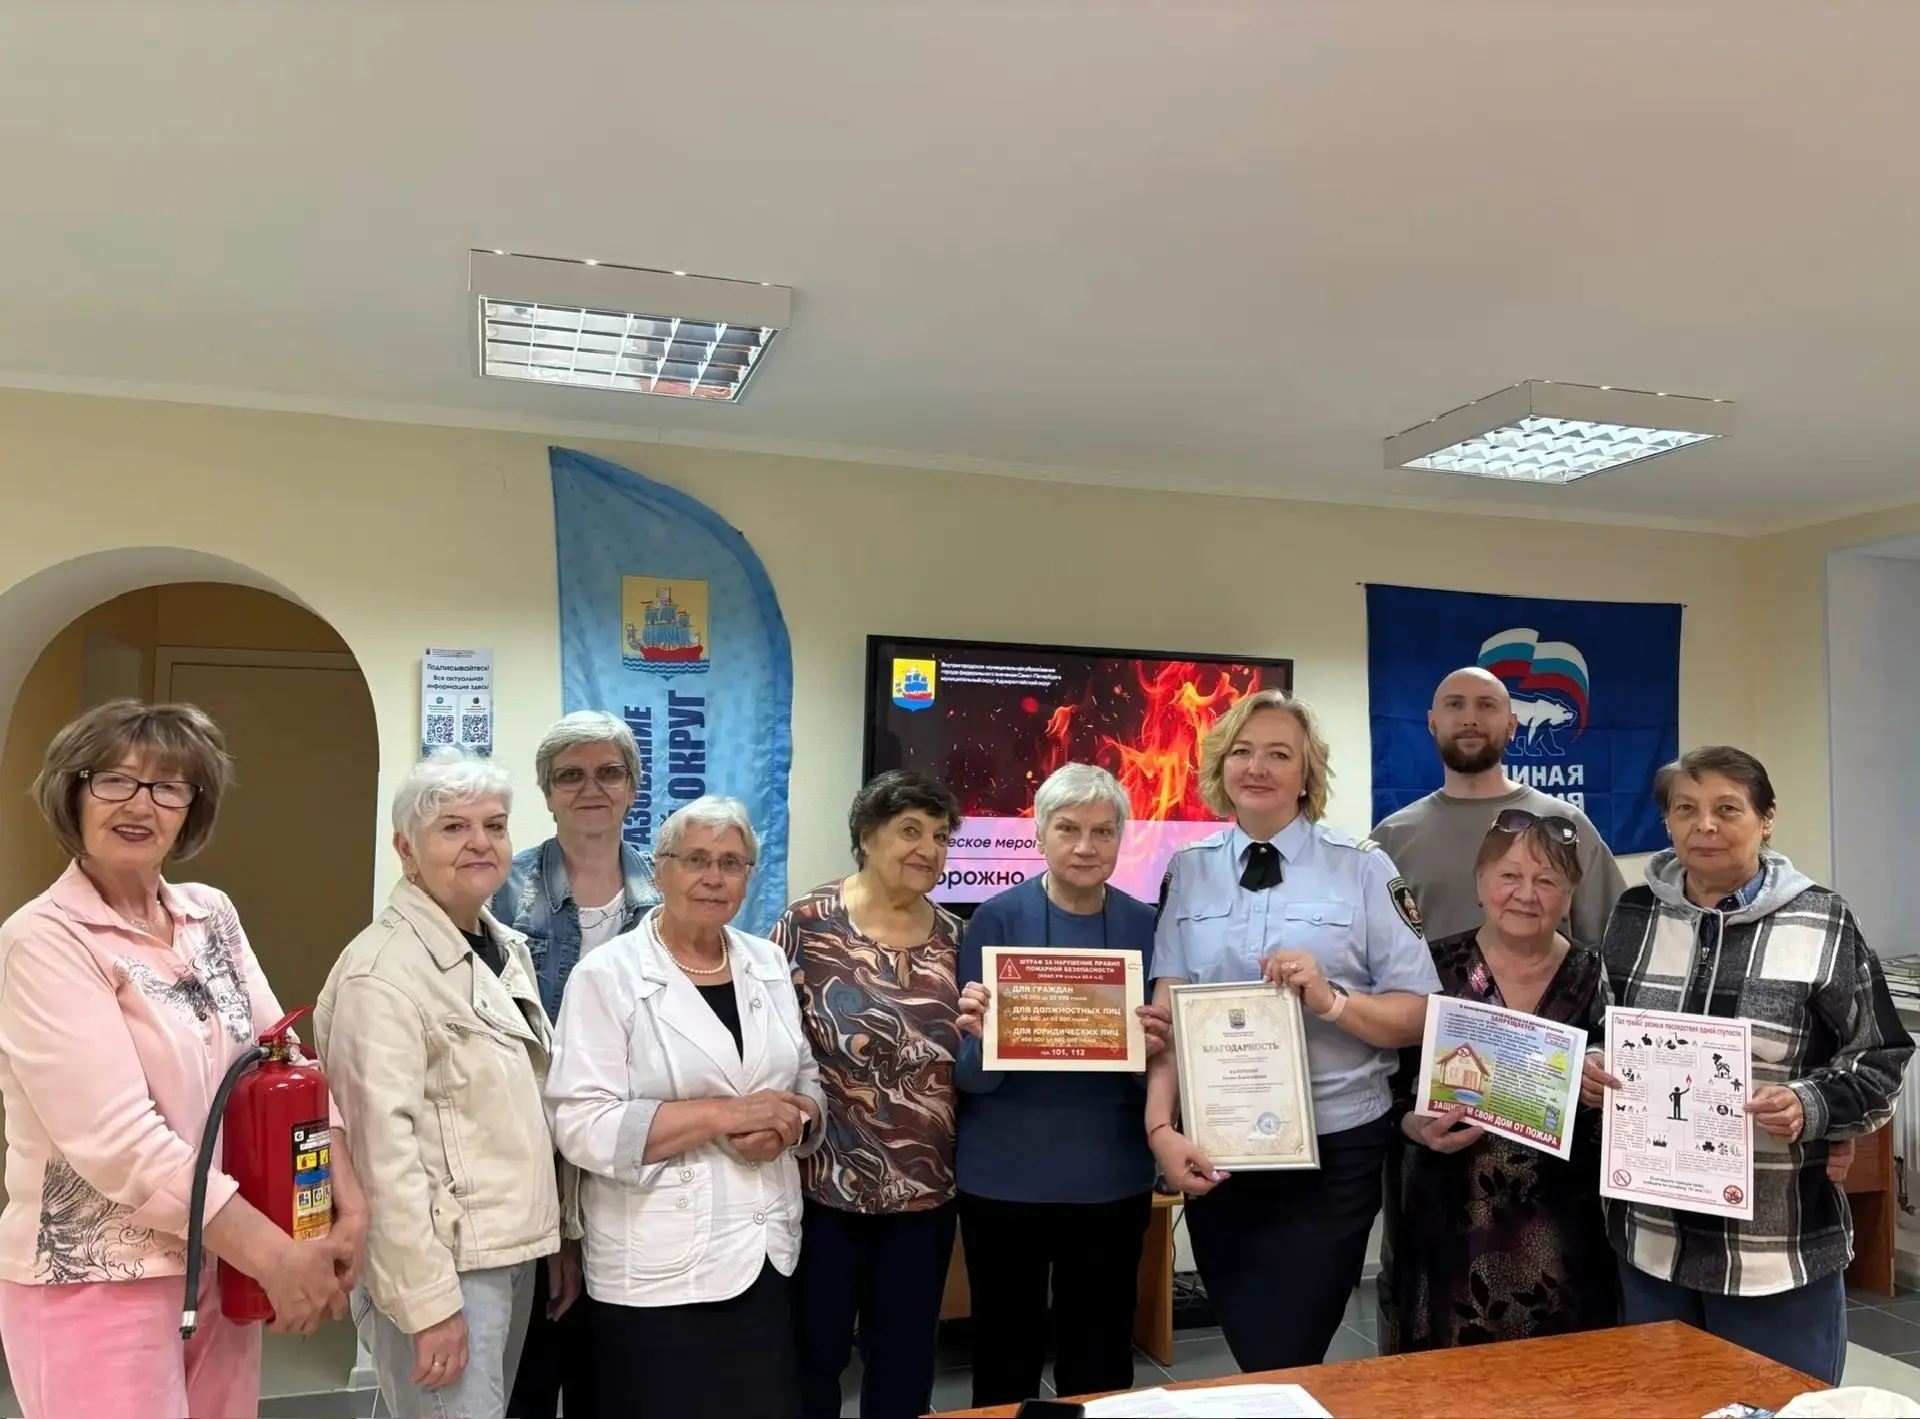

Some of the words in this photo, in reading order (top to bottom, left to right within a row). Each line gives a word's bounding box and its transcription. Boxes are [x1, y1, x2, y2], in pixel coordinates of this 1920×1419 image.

[427, 663, 490, 672] Подписывайтесь!
[668, 690, 706, 800] ОКРУГ
[948, 838, 991, 848] еское
[937, 871, 1025, 889] орожно
[1012, 986, 1030, 994] ДЛЯ
[1033, 986, 1074, 994] ГРАЖДАН
[1012, 1007, 1031, 1015] ДЛЯ
[1033, 1007, 1101, 1015] ДОЛЖНОСТНЫХ
[1103, 1008, 1122, 1016] ЛИЦ
[1033, 1028, 1098, 1036] ЮРИДИЧЕСКИХ
[1099, 1029, 1120, 1037] ЛИЦ
[1202, 1043, 1279, 1053] БЛАГОДАРНОСТЬ
[1433, 1101, 1473, 1115] ЗАЩИМ
[1494, 1116, 1513, 1131] ДОМ
[1513, 1122, 1524, 1132] ОТ
[1525, 1126, 1557, 1146] ПОЖАРА
